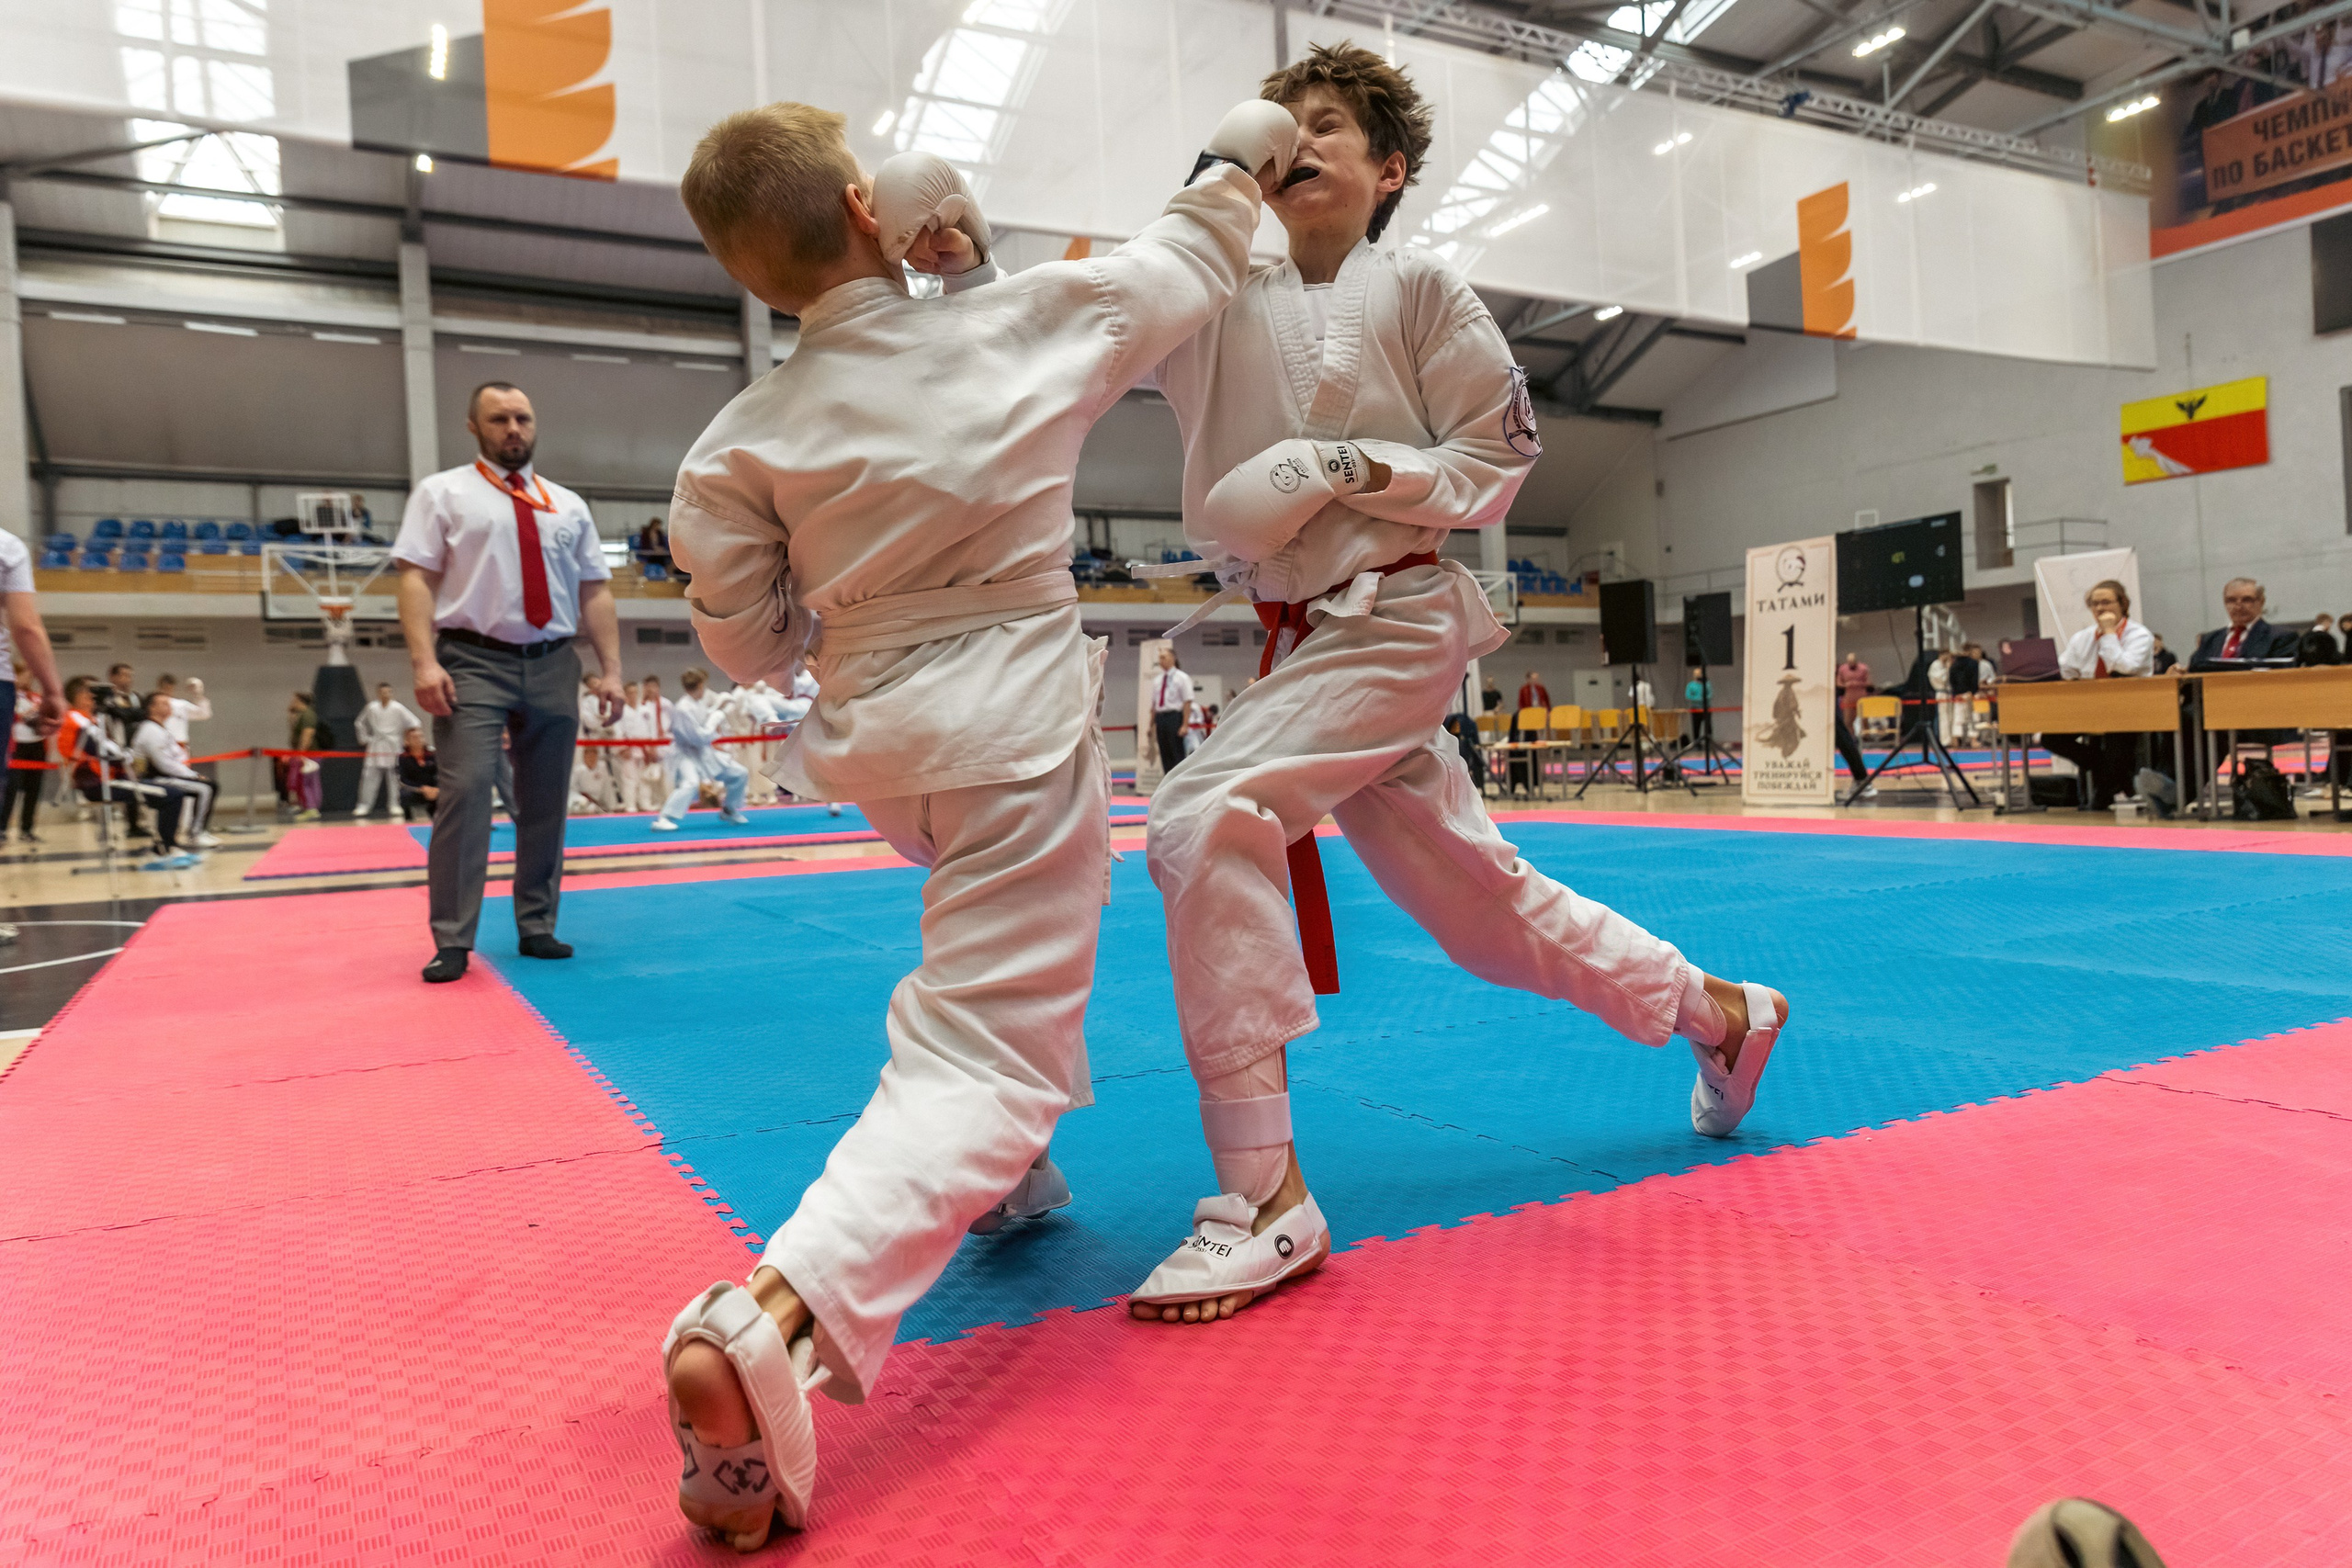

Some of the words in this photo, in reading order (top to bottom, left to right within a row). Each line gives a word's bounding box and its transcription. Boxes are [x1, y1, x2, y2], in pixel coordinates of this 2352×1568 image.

[2212, 159, 2244, 188] ПО
[1337, 446, 1355, 484] SENTEI
[1756, 592, 1826, 613] ТАТАМИ
[1781, 624, 1798, 671] 1
